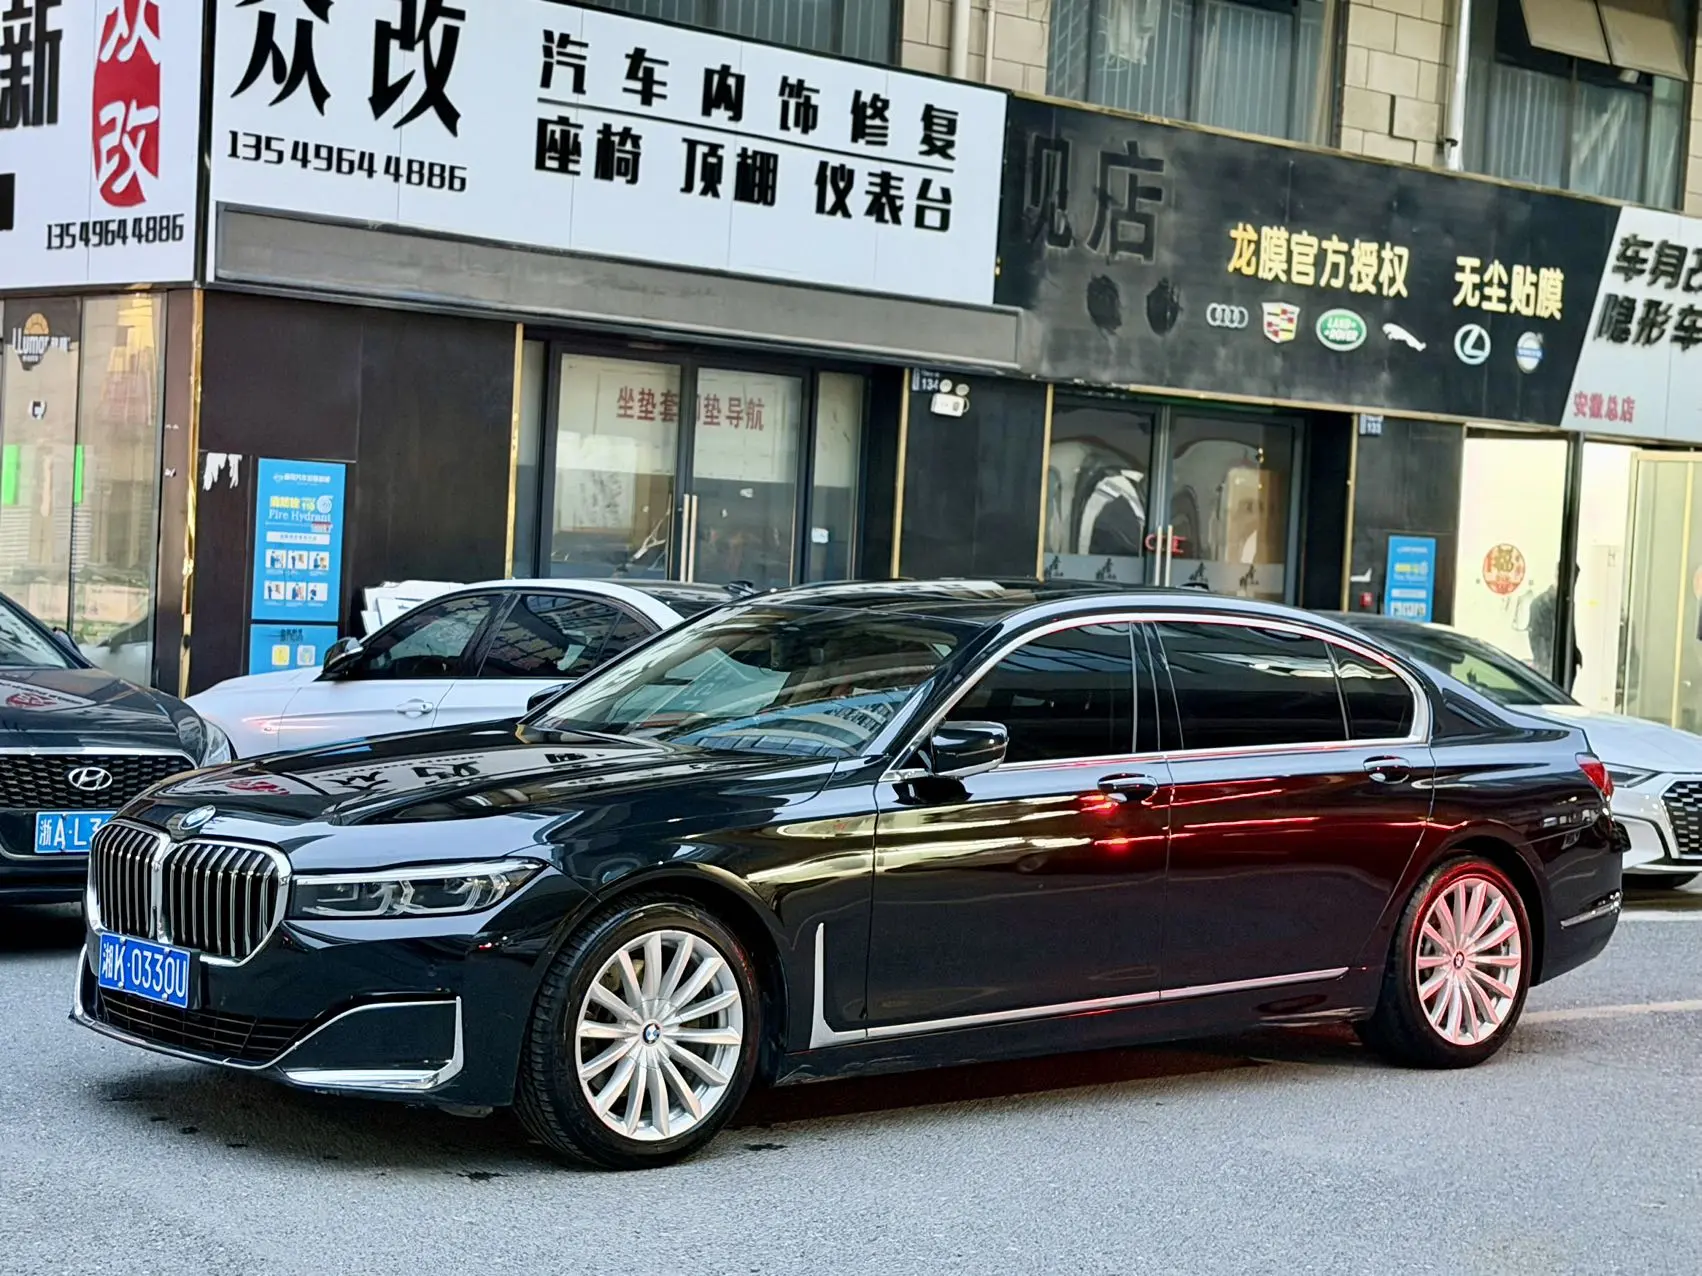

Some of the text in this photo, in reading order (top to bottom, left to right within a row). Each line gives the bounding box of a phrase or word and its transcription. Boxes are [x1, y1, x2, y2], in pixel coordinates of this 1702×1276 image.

[538, 28, 961, 162] 汽车内饰修复
[534, 115, 954, 233] 座椅 顶棚 仪表台
[1227, 221, 1410, 298] 龙膜官方授权
[1452, 255, 1565, 321] 无尘贴膜
[268, 508, 289, 520] Fire
[291, 510, 332, 524] Hydrant
